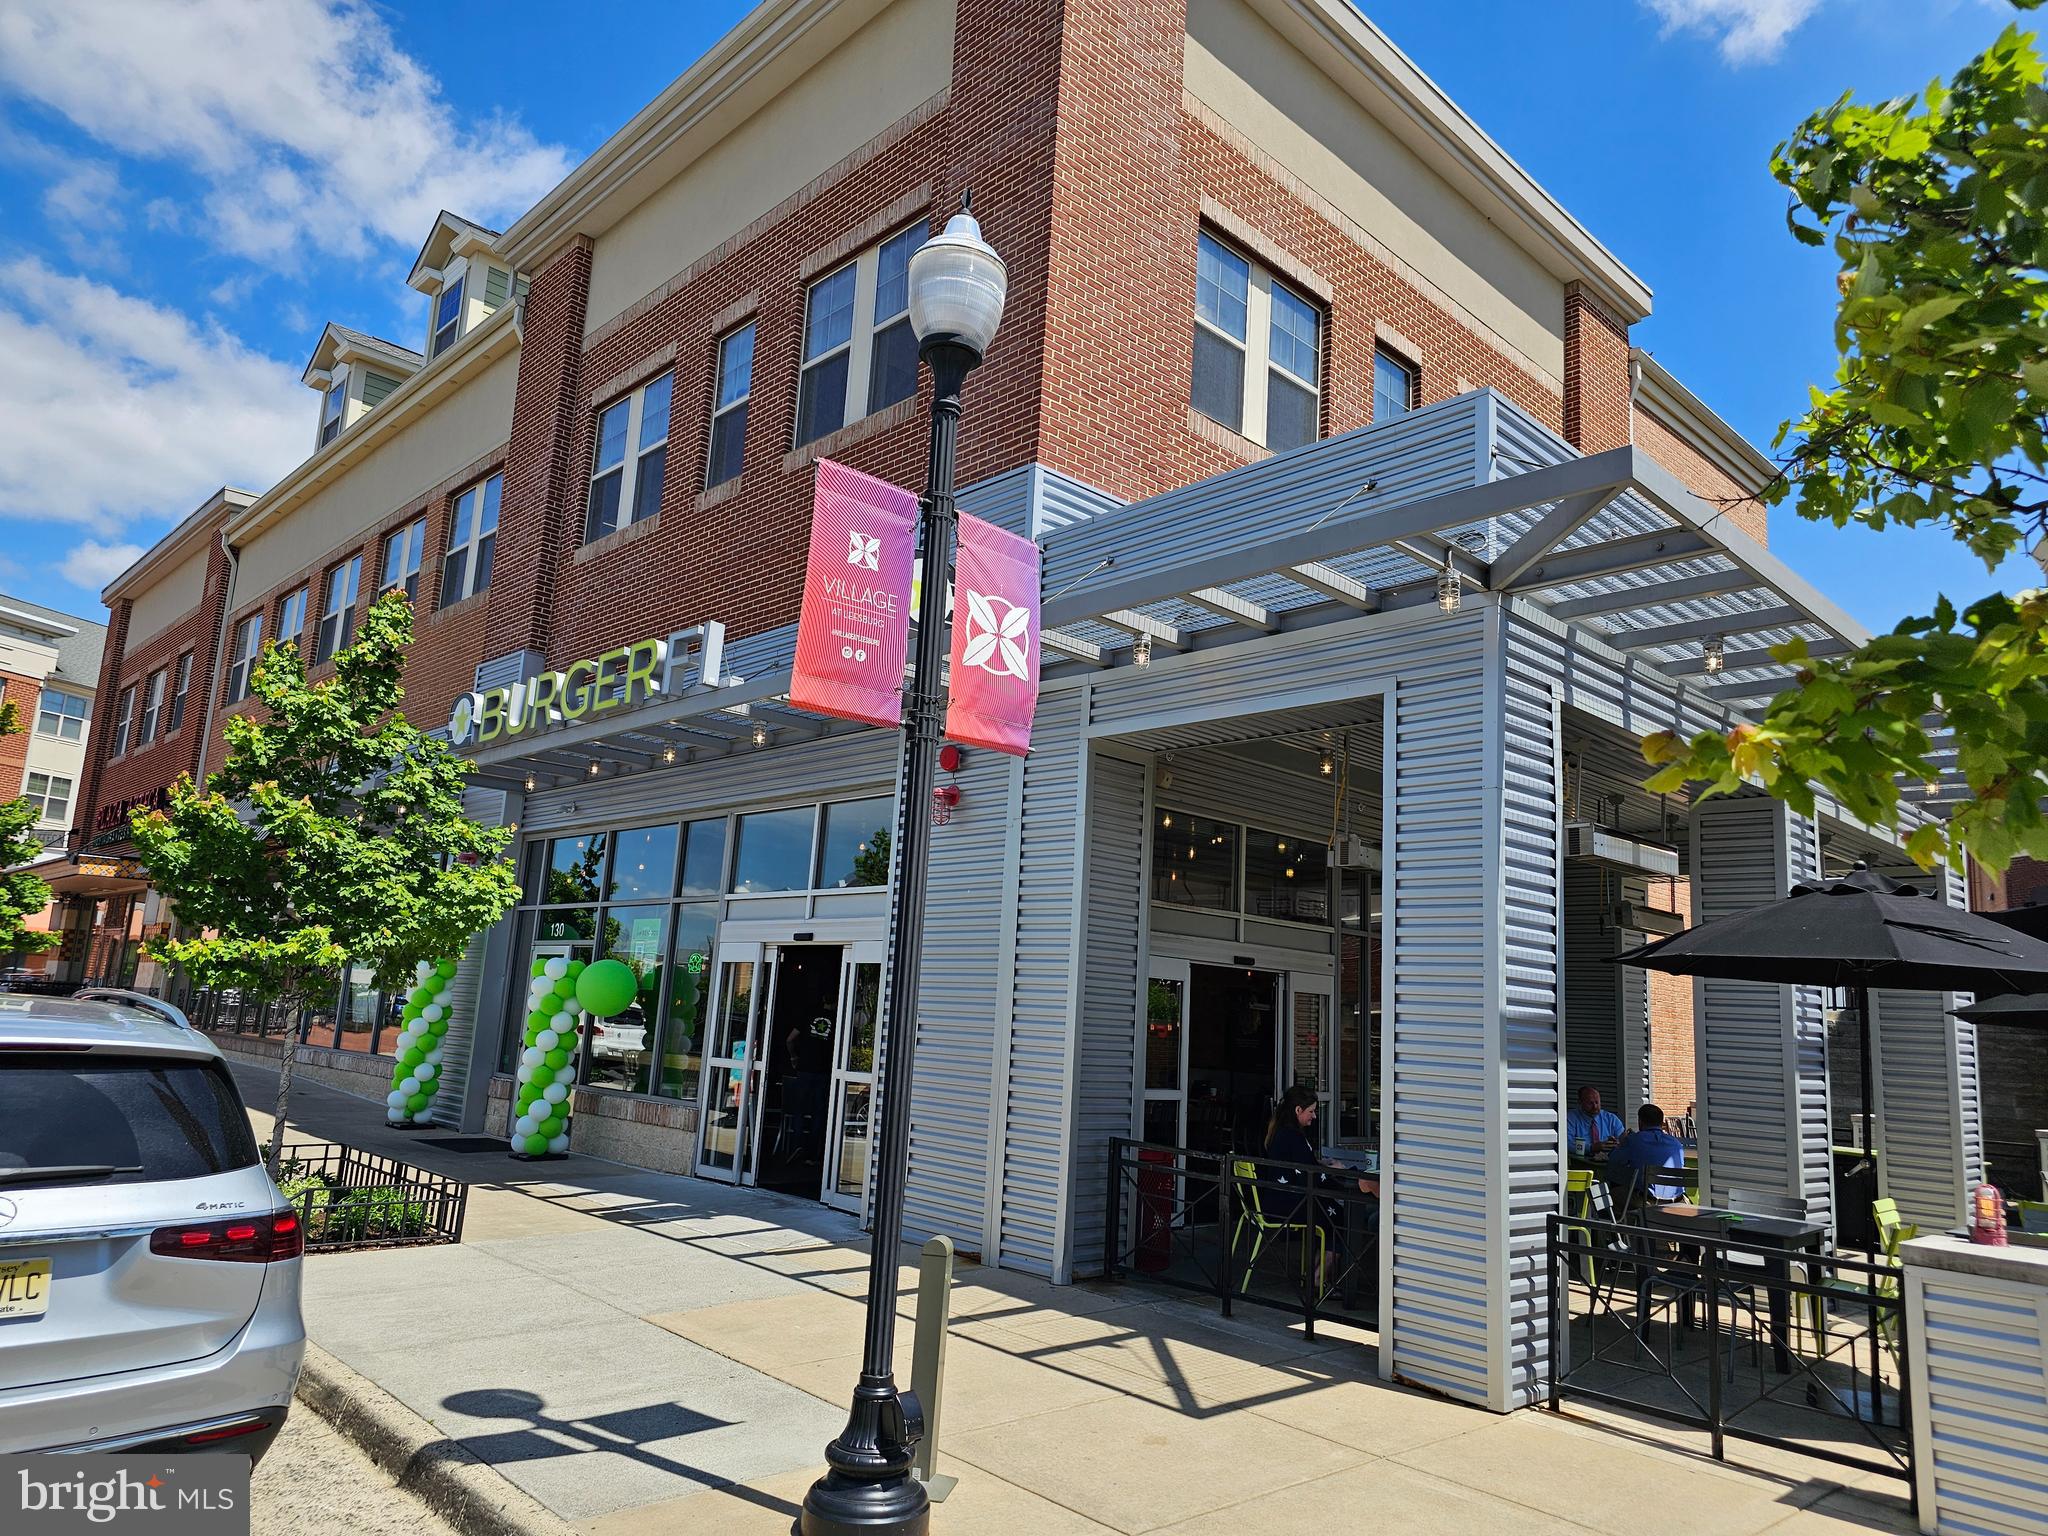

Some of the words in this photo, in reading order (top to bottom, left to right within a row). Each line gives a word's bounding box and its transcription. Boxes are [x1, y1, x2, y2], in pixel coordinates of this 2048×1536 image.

[823, 574, 899, 613] VILLAGE
[831, 607, 842, 617] AT
[843, 610, 885, 628] LEESBURG
[550, 922, 565, 937] 130
[195, 1201, 245, 1211] 4MATIC
